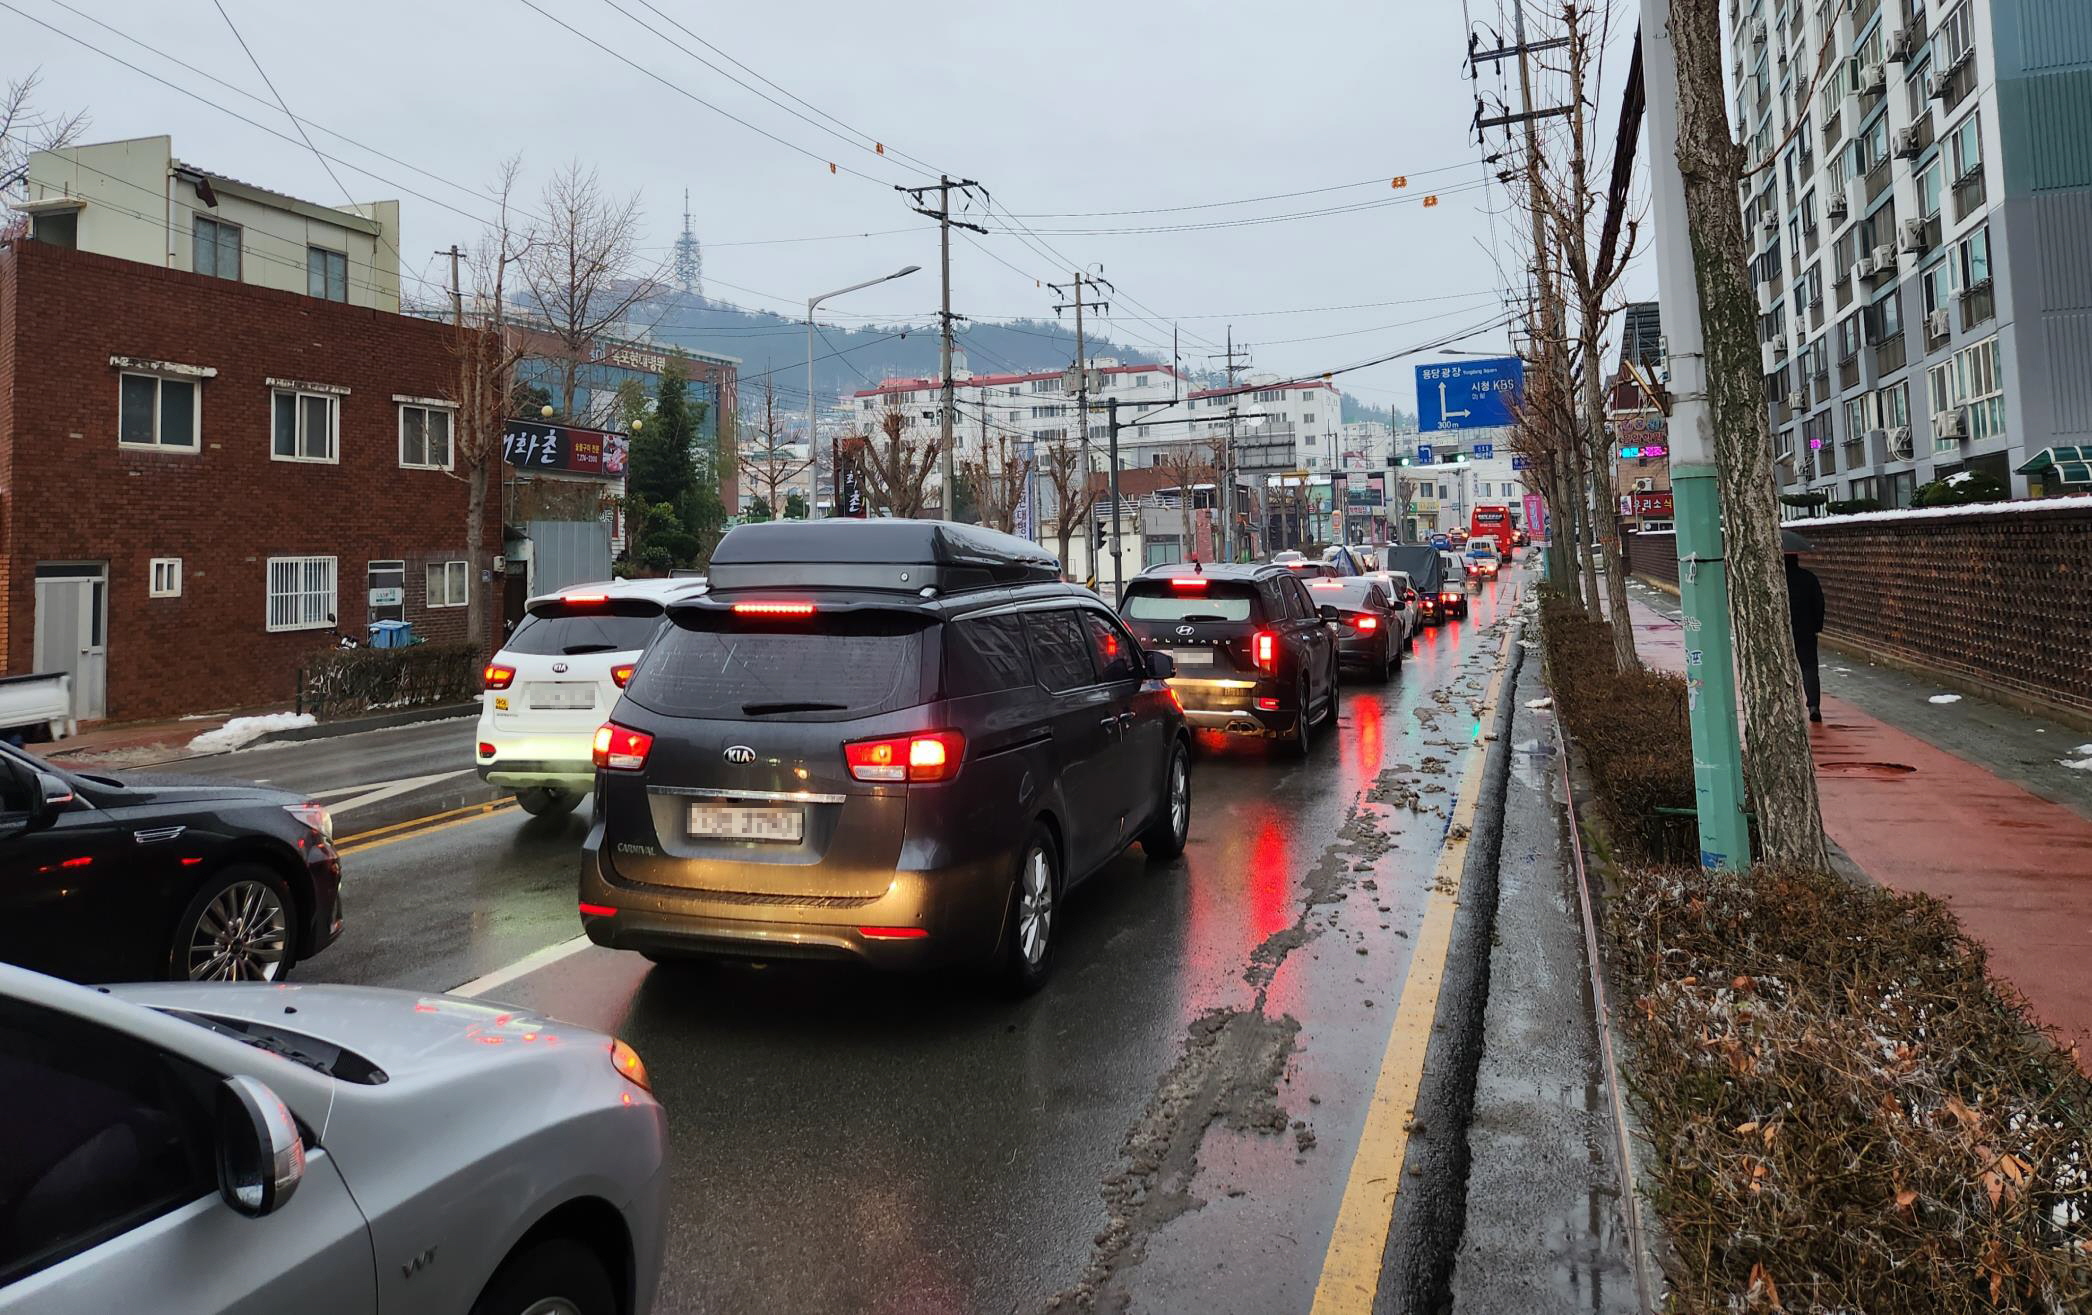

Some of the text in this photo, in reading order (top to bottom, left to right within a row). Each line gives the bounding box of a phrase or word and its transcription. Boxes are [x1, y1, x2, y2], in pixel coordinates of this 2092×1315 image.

[1422, 366, 1462, 380] 용당광장
[1471, 378, 1514, 392] 시청 KBS
[552, 664, 567, 672] KIA
[728, 749, 750, 763] KIA
[617, 842, 657, 857] CARNIVAL
